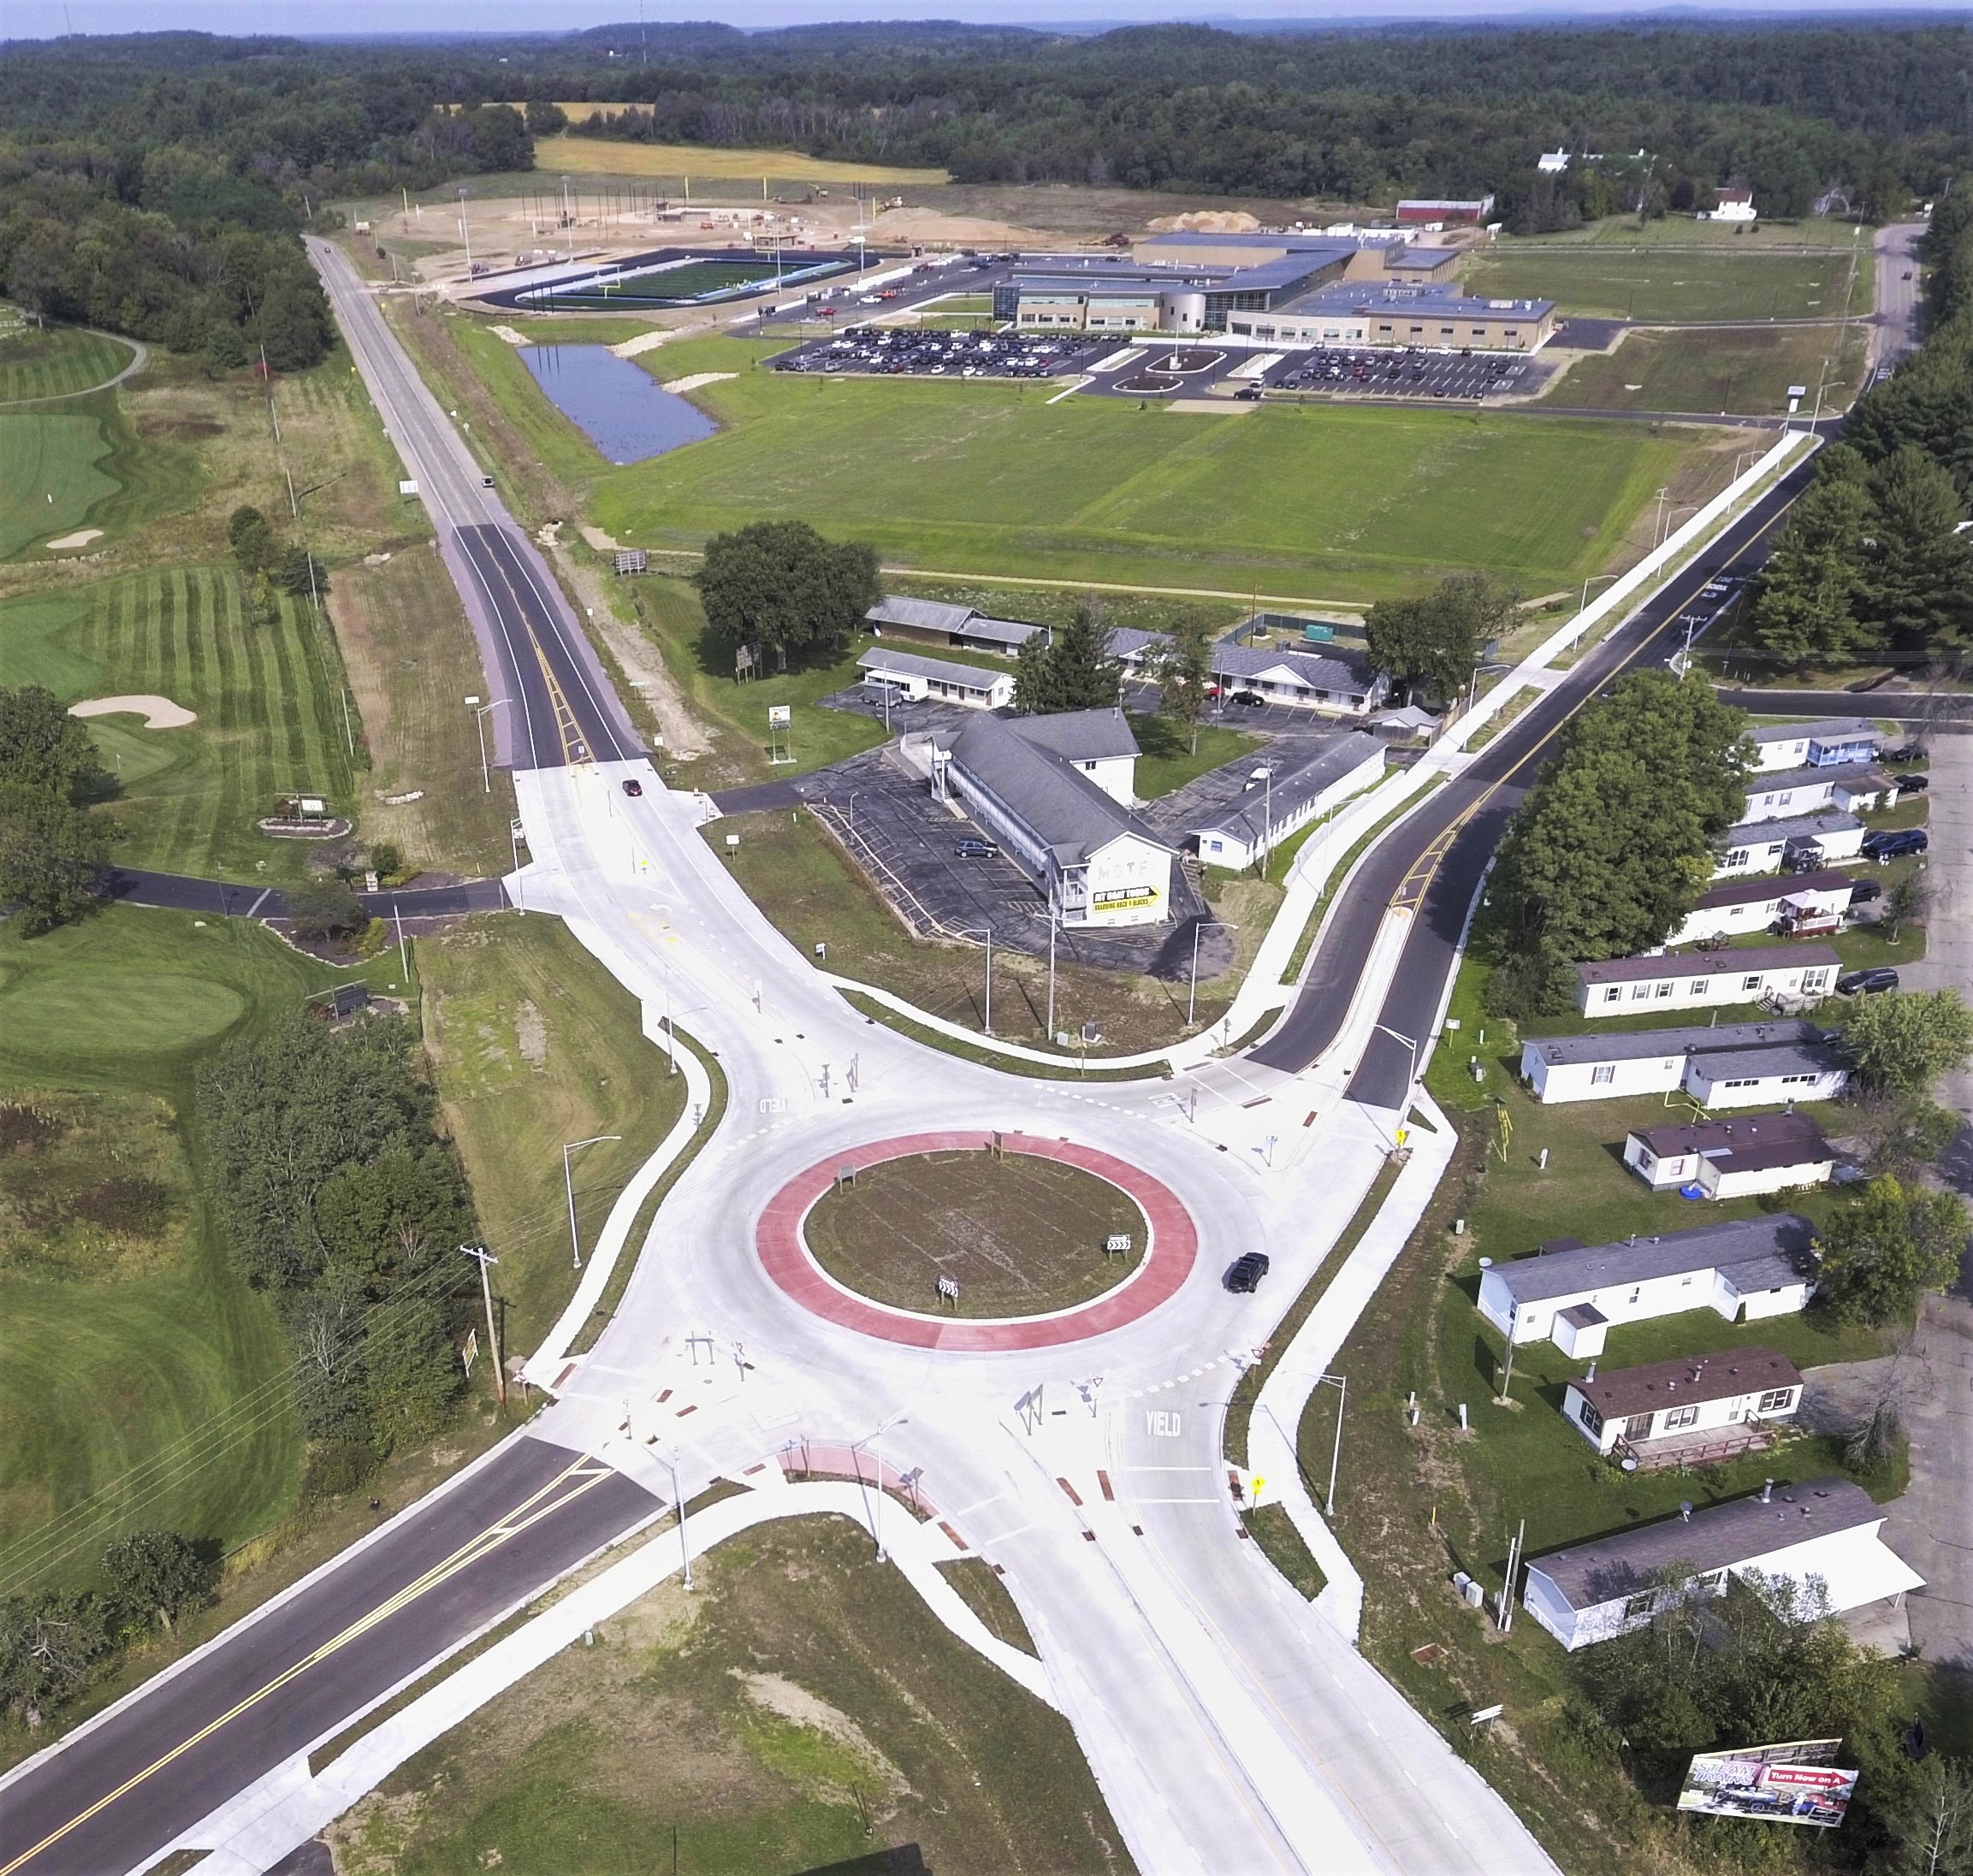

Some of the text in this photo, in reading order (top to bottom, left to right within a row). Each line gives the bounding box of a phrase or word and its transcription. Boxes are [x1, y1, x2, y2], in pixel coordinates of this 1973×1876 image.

[1146, 1410, 1181, 1436] YIELD
[1695, 1762, 1756, 1776] STEAM
[1693, 1771, 1755, 1785] TRAINS
[1771, 1771, 1793, 1780] Turn
[1796, 1773, 1816, 1782] Now
[1817, 1775, 1831, 1784] on
